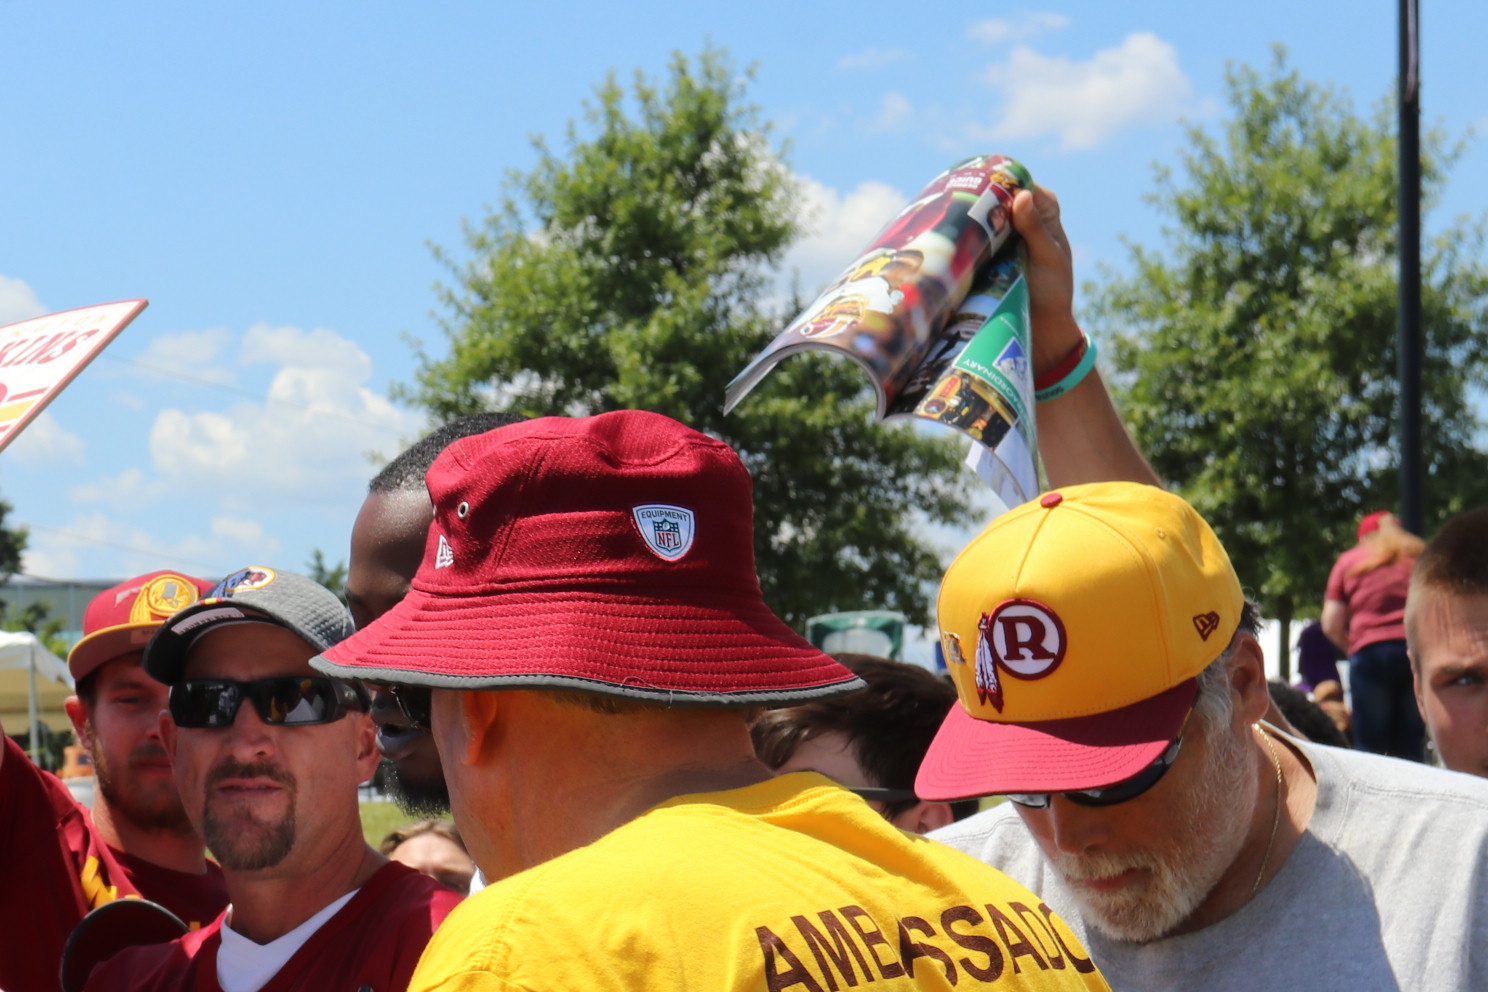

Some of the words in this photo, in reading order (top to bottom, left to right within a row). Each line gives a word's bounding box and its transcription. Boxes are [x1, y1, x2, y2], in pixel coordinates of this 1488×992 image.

[641, 510, 687, 521] EQUIPMENT
[657, 532, 679, 548] NFL
[997, 615, 1056, 660] R
